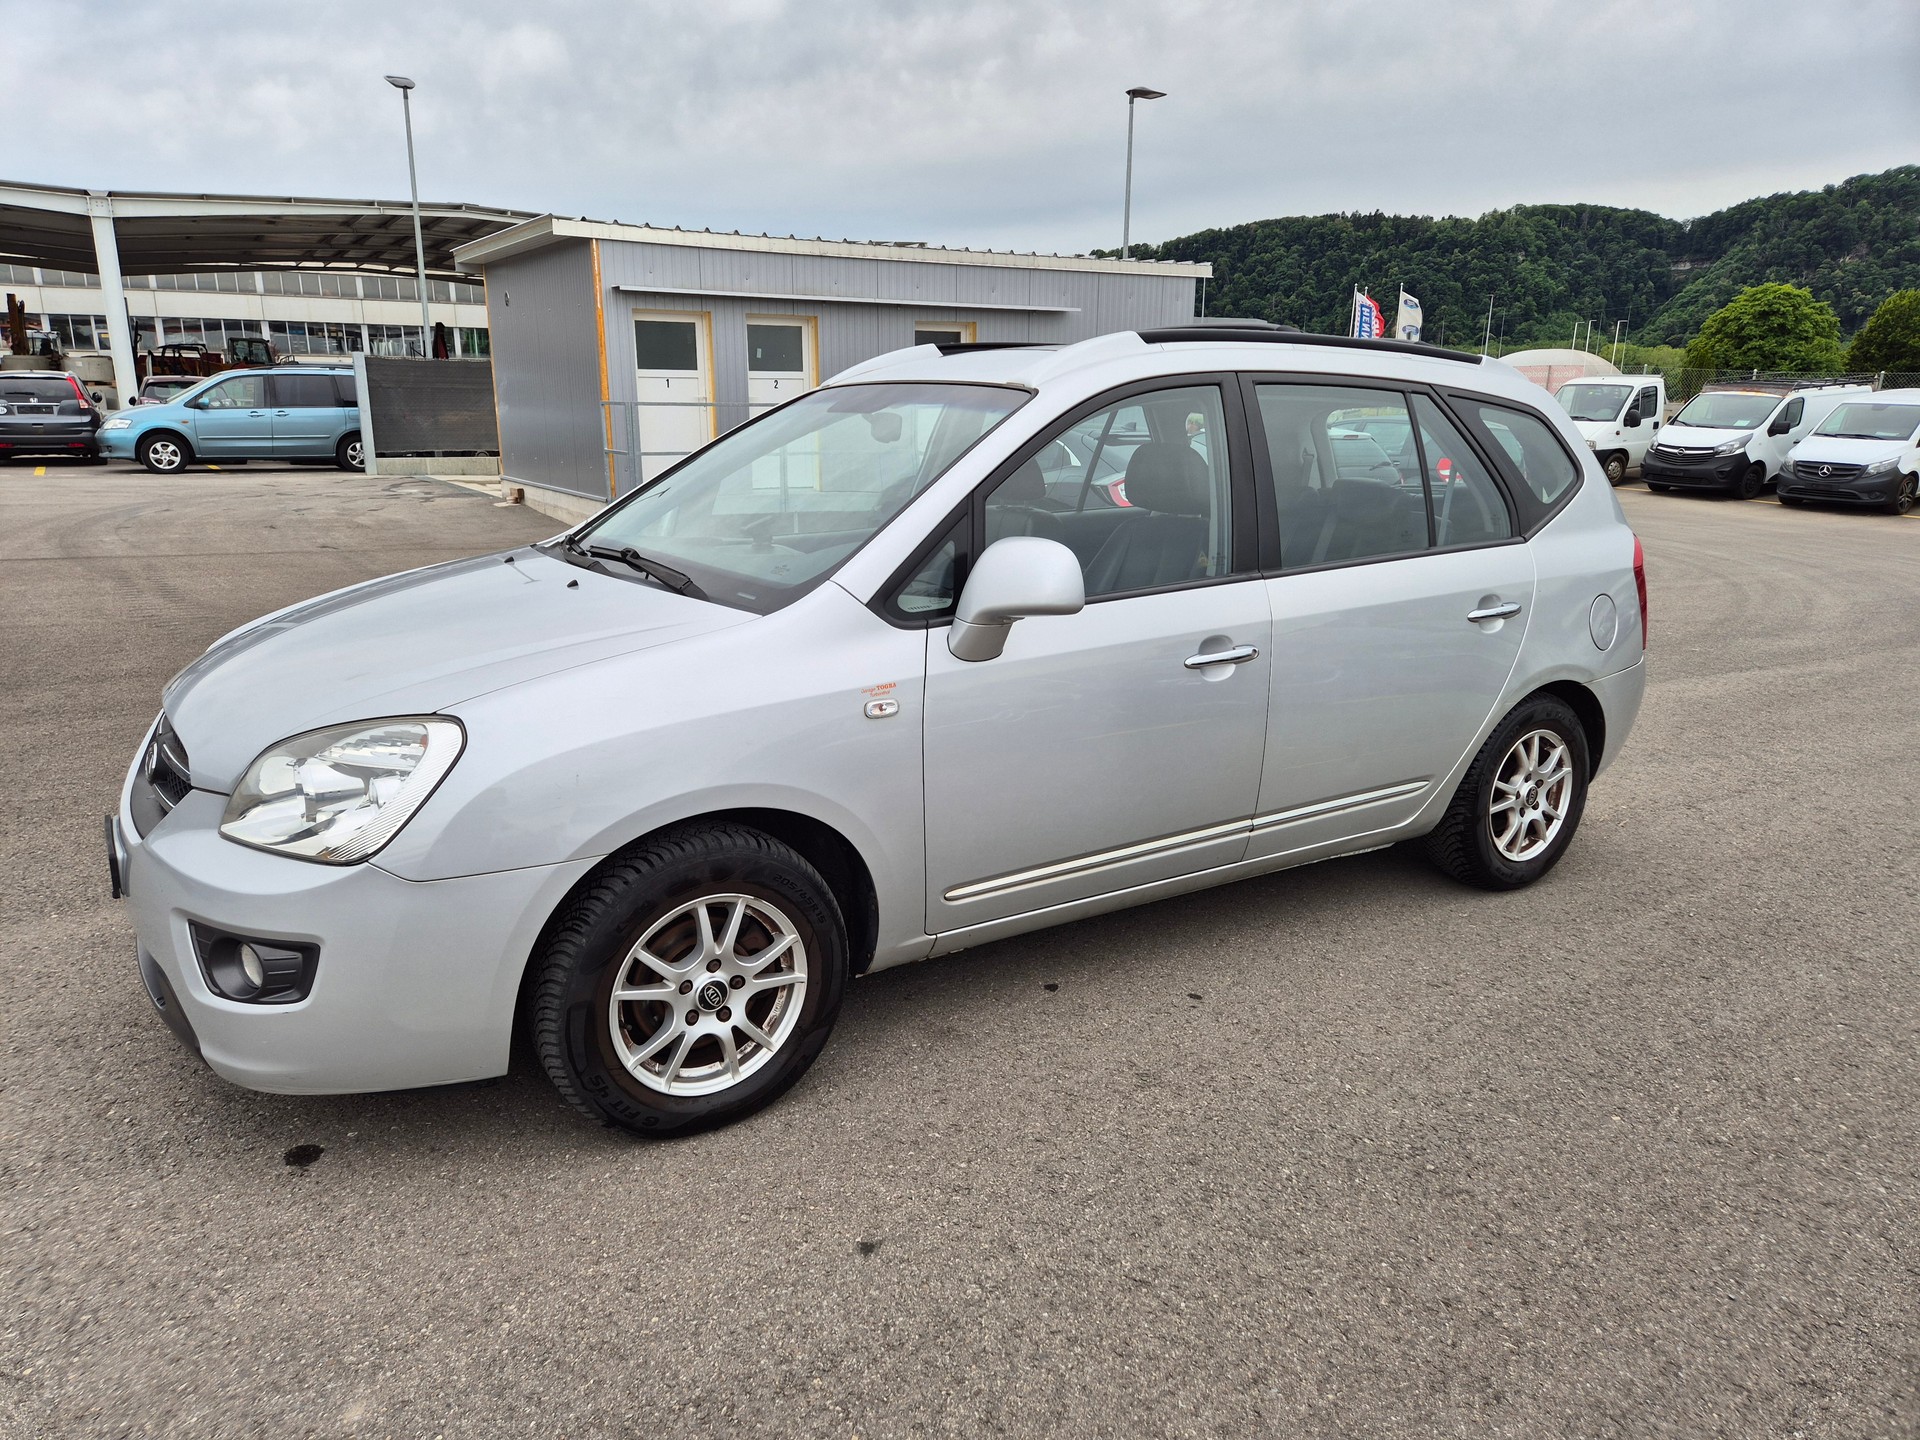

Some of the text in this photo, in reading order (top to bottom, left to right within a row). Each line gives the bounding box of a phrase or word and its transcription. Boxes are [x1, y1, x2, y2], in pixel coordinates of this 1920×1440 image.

[665, 378, 670, 388] 1
[773, 379, 779, 389] 2
[706, 987, 720, 1005] KIA
